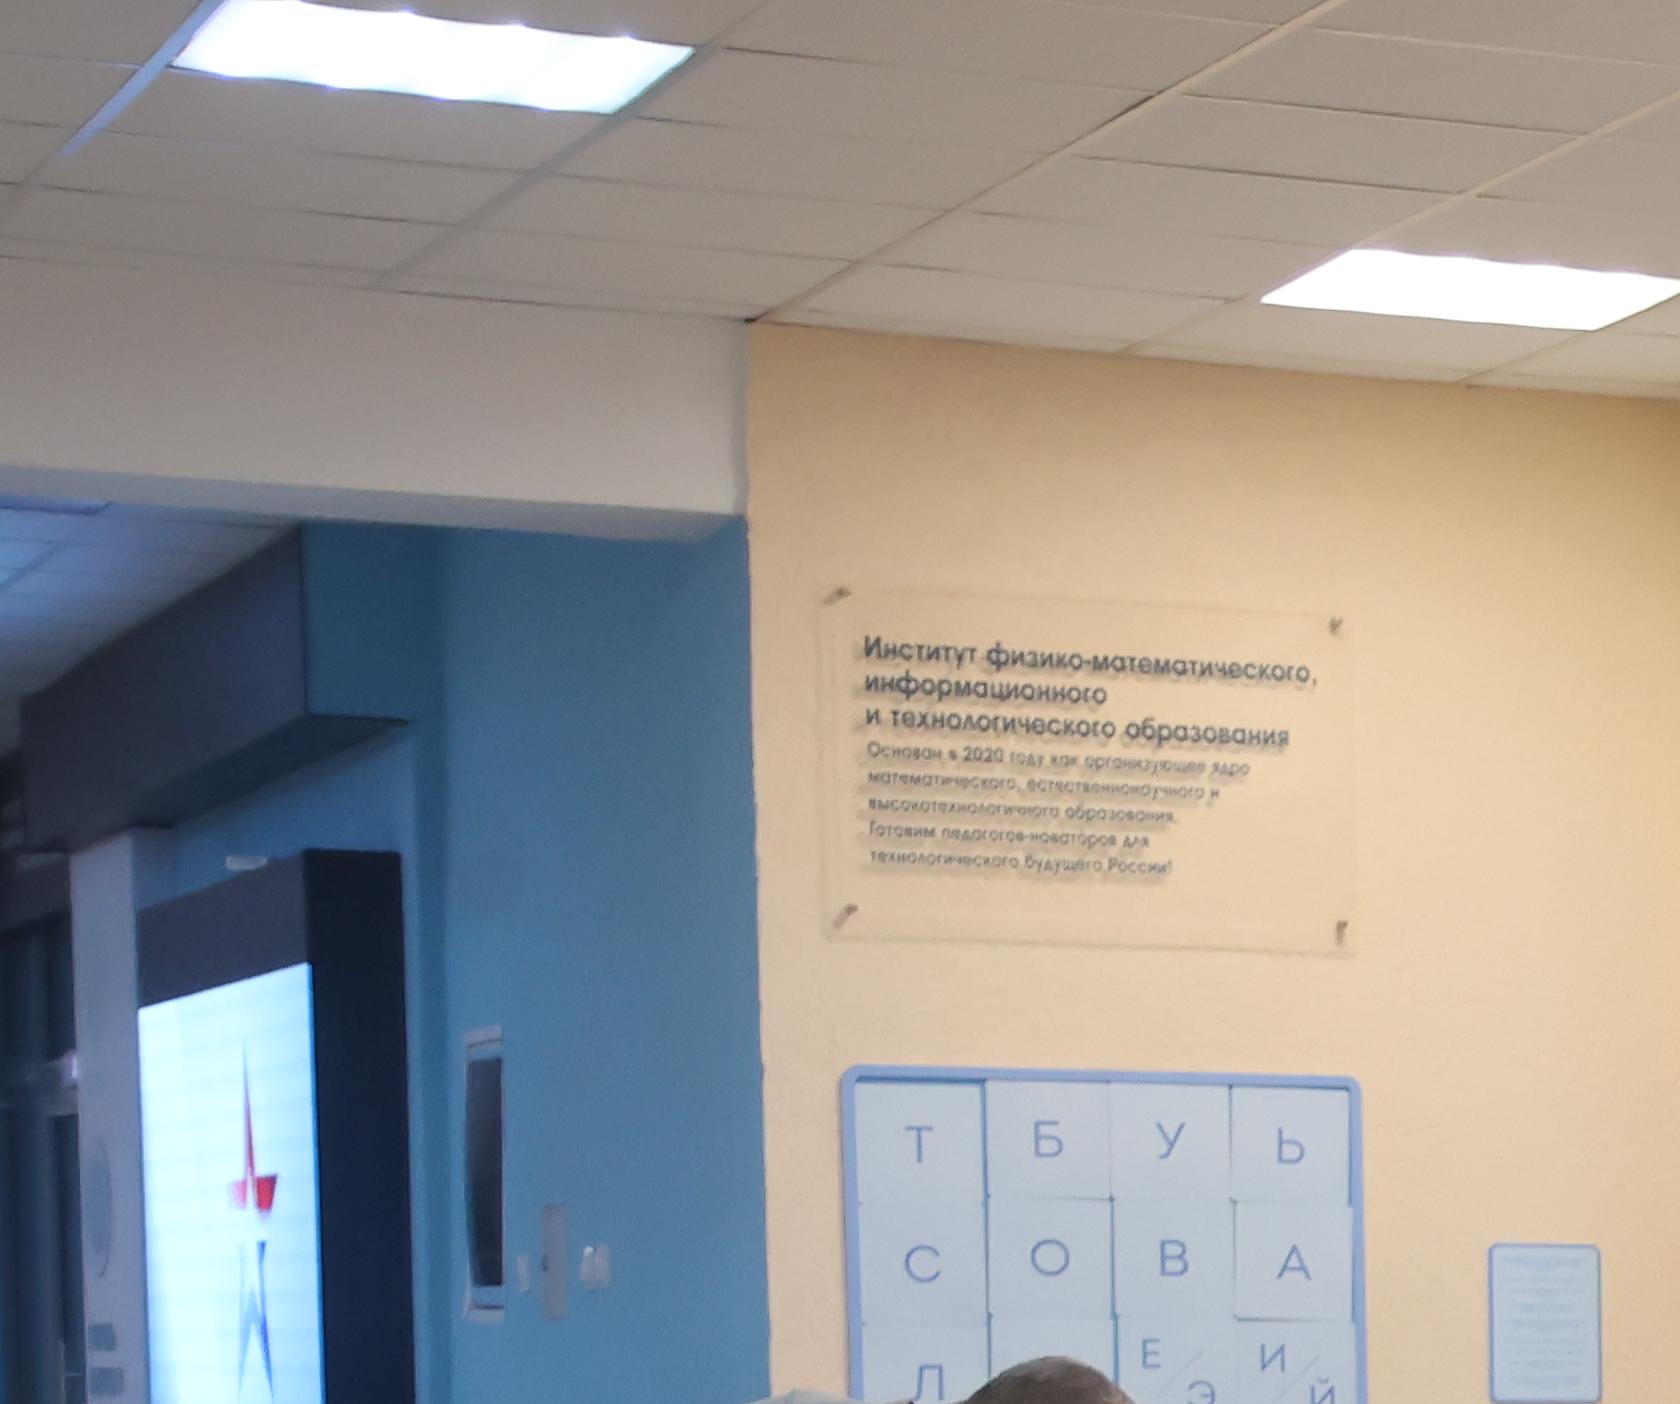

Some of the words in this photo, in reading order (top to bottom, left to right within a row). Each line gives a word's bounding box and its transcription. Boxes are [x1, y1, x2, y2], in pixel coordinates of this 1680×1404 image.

[864, 635, 977, 669] Институт
[986, 640, 1317, 686] физико-математического,
[865, 670, 1107, 704] информационного
[865, 709, 881, 725] и
[891, 710, 1116, 738] технологического
[1125, 717, 1289, 747] образования
[867, 741, 942, 761] Основан
[905, 1125, 933, 1163] Т
[1033, 1120, 1063, 1158] Б
[1156, 1121, 1185, 1159] У
[1278, 1127, 1305, 1165] Ь
[904, 1244, 942, 1284] С
[1031, 1239, 1070, 1277] О
[1160, 1239, 1190, 1277] В
[1276, 1244, 1312, 1281] А
